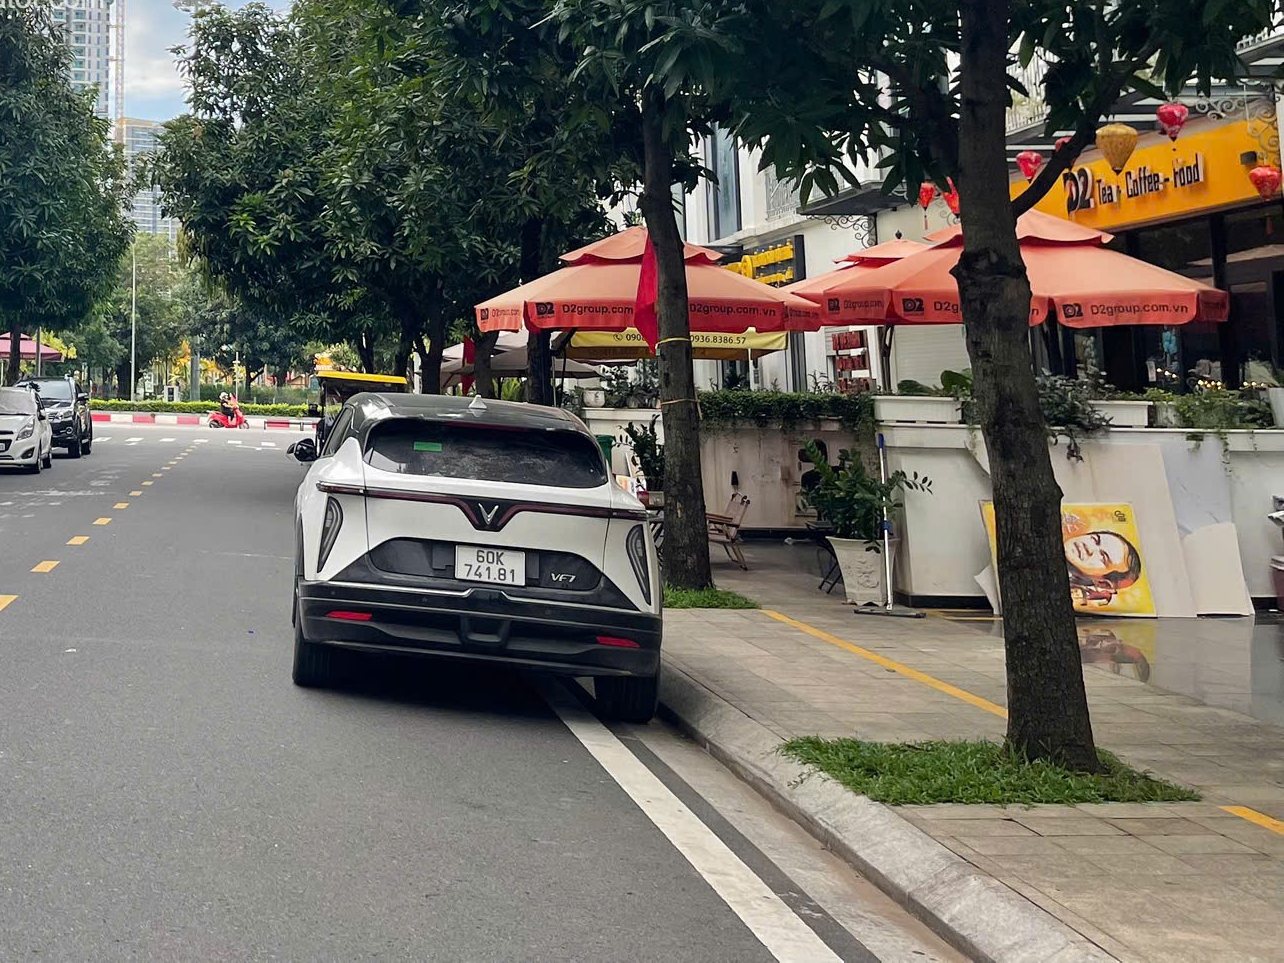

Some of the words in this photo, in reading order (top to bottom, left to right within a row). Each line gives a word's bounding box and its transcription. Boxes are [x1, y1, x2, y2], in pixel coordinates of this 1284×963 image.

[1096, 178, 1115, 205] Tea
[1125, 166, 1162, 198] Coffee
[535, 302, 555, 316] D2
[562, 304, 634, 316] D2group.com
[689, 303, 776, 317] D2group.com.vn
[902, 298, 924, 312] D2
[1062, 303, 1083, 318] D2
[1091, 303, 1188, 316] D2group.com.vn
[476, 550, 504, 565] 60K
[465, 564, 515, 582] 741.81
[550, 573, 577, 582] VF7
